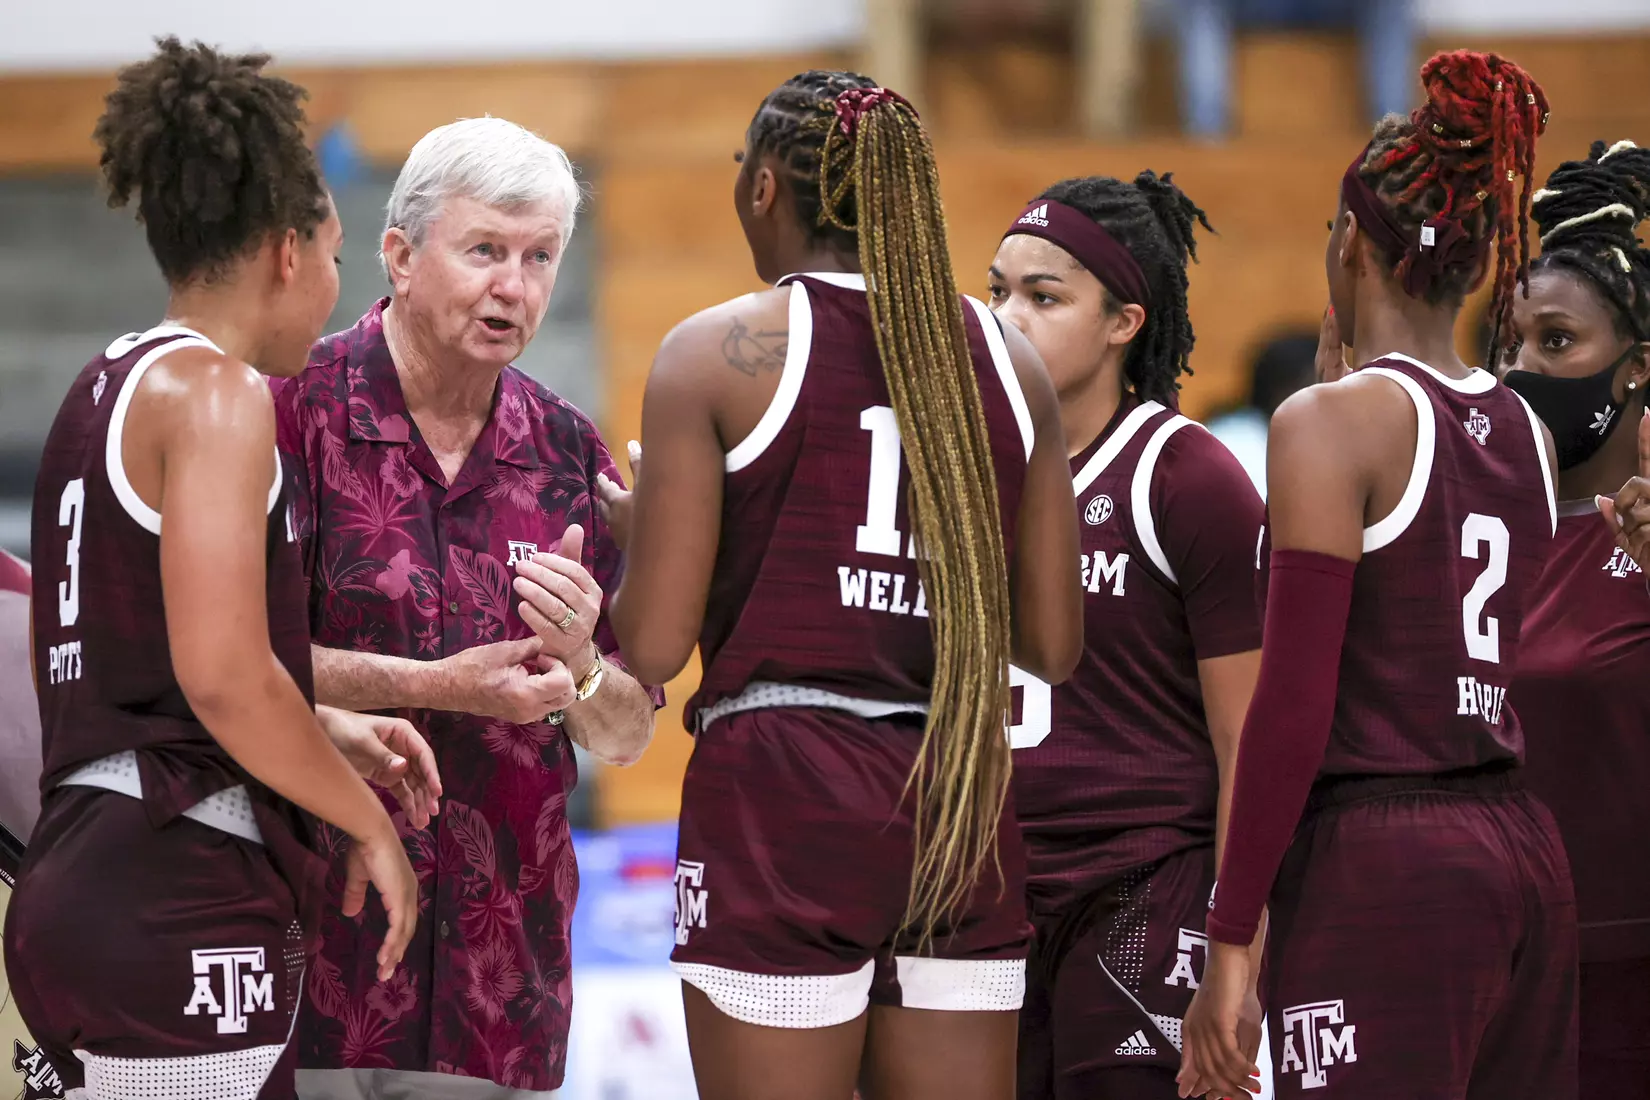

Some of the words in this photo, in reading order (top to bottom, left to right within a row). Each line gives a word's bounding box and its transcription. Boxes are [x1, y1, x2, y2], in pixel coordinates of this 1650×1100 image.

[1018, 216, 1049, 227] adidas
[1087, 497, 1110, 523] SEC
[58, 478, 85, 627] 3
[1461, 513, 1510, 663] 2
[49, 640, 82, 684] PITTS
[1115, 1045, 1157, 1056] adidas
